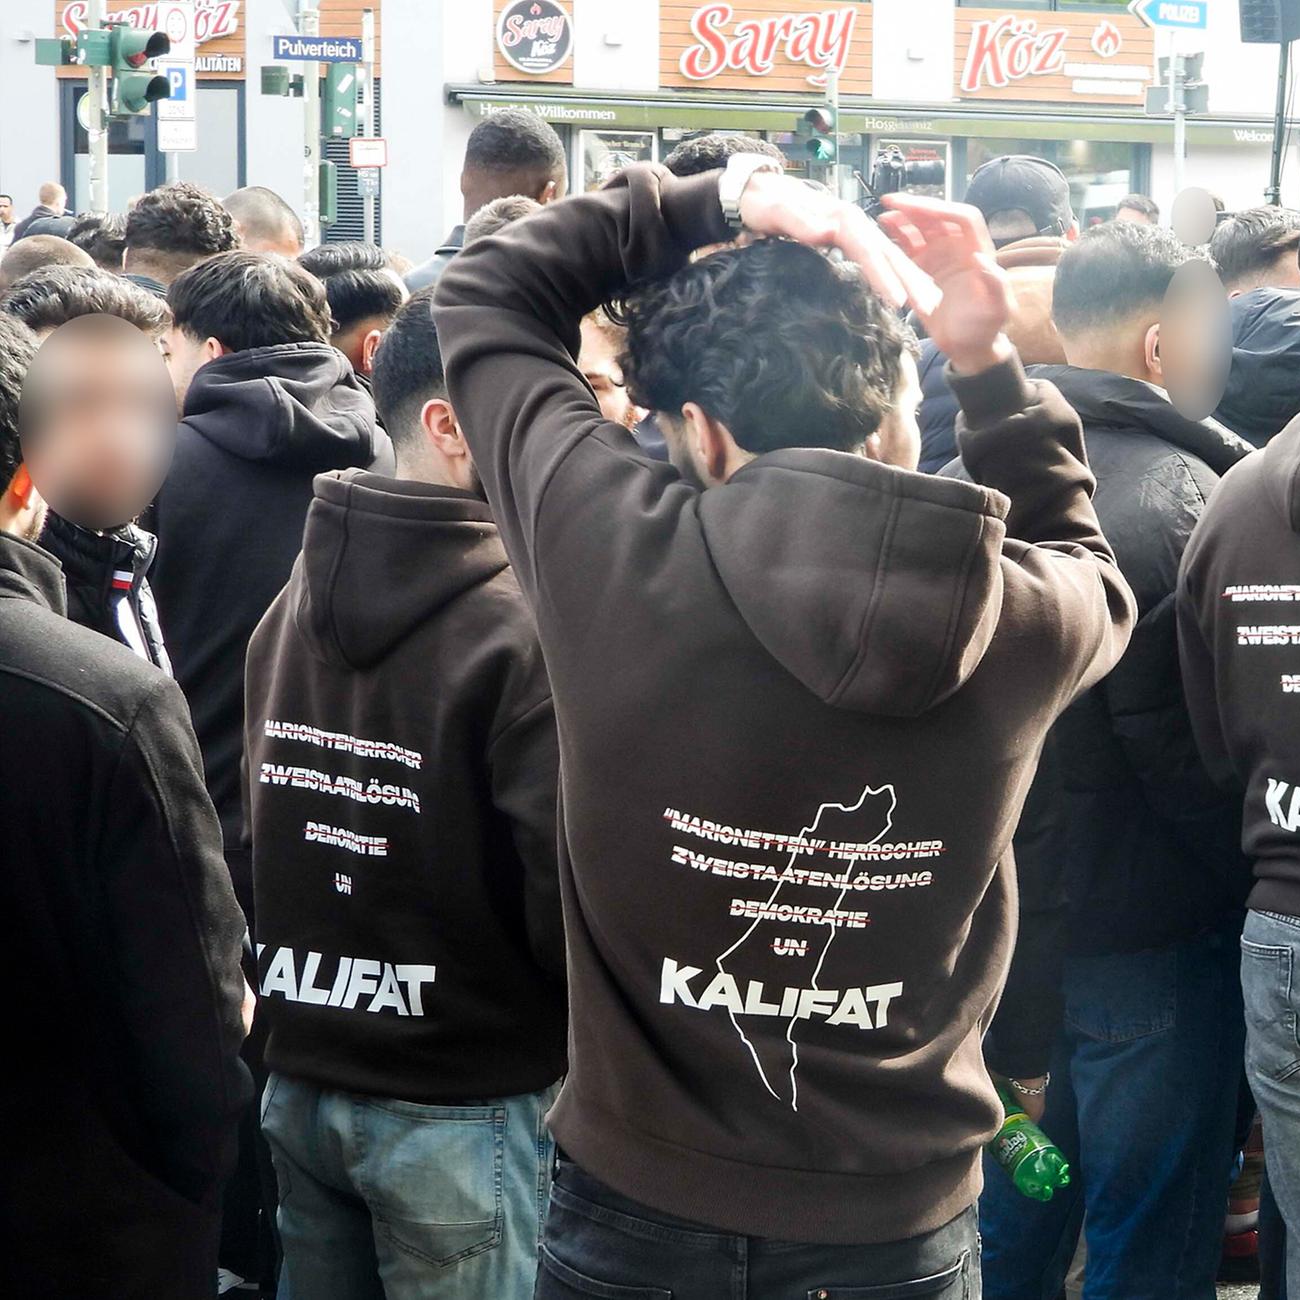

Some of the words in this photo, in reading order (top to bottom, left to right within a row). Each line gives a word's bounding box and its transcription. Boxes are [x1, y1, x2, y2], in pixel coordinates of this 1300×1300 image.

[1159, 3, 1199, 24] POLIZEI
[503, 15, 565, 47] Saray
[680, 3, 857, 87] Saray
[279, 39, 356, 58] Pulverteich
[961, 15, 1068, 91] Köz
[170, 71, 183, 96] P
[535, 105, 616, 120] Willkommen
[828, 839, 944, 860] HERRSCHER
[671, 845, 934, 891] ZWEISTAATENLÖSUNG
[730, 899, 868, 928] DEMOKRATIE
[773, 937, 807, 956] UN
[256, 943, 436, 1016] ALIFAT
[659, 956, 903, 1030] KALIFAT
